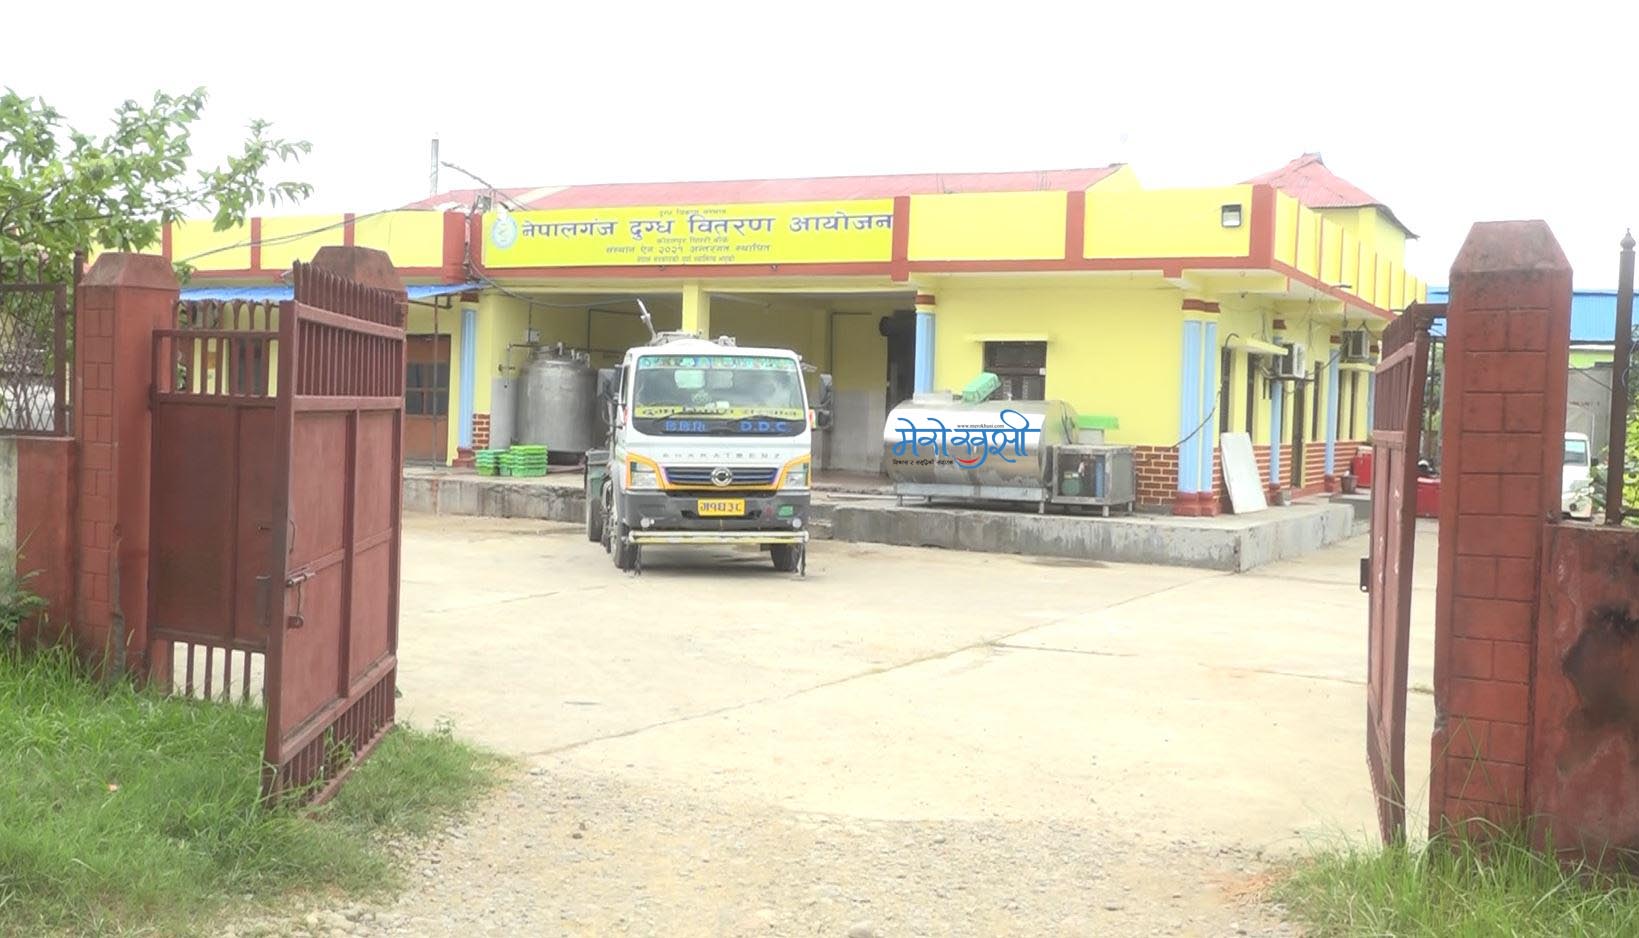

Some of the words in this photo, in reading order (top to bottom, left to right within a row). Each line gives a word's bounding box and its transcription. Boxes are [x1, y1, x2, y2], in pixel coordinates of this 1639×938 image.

[522, 218, 618, 238] नेपालगंज
[630, 219, 675, 241] दुग्ध
[687, 214, 776, 236] वितरण
[789, 211, 893, 232] आयोजन
